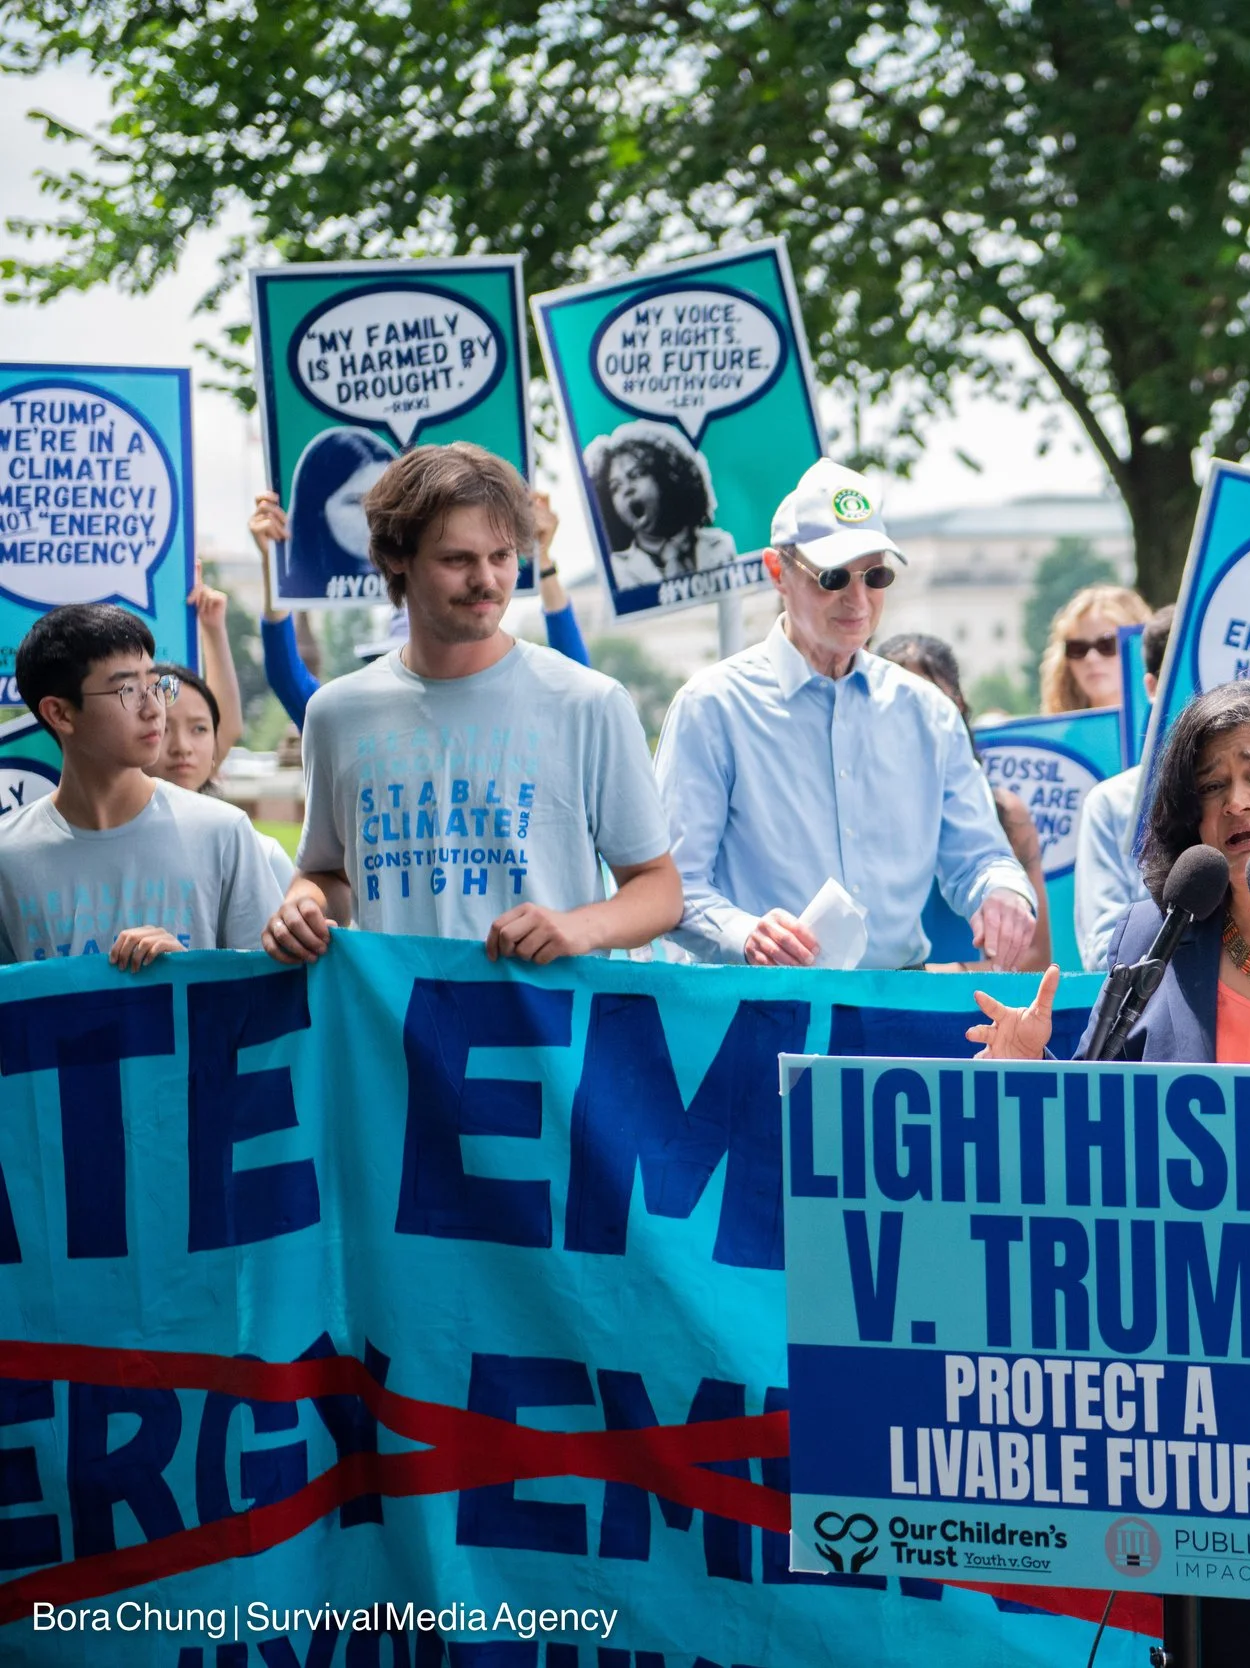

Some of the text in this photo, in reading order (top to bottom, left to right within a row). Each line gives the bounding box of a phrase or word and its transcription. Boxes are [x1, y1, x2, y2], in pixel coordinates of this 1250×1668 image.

[366, 313, 459, 348] FAMILY
[635, 307, 663, 326] MY
[621, 330, 650, 348] MY
[307, 333, 493, 382] IS HARMED BY
[604, 347, 770, 376] OUR FUTURE.
[89, 430, 114, 454] IN
[127, 432, 146, 454] A
[8, 457, 132, 481] CLIMATE
[361, 779, 536, 814] STABLE
[1029, 786, 1081, 810] ARE
[362, 807, 513, 845] CLIMATE
[517, 810, 531, 839] OUR
[363, 847, 529, 871] CONSTITUTIONAL
[366, 867, 528, 901] RIGHT
[0, 966, 322, 1264] TE
[842, 1209, 937, 1345] V.
[944, 1354, 1219, 1437] PROTECT A
[889, 1425, 1089, 1505] LIVABLE
[888, 1515, 1068, 1549] Our Children's
[890, 1541, 959, 1567] Trust
